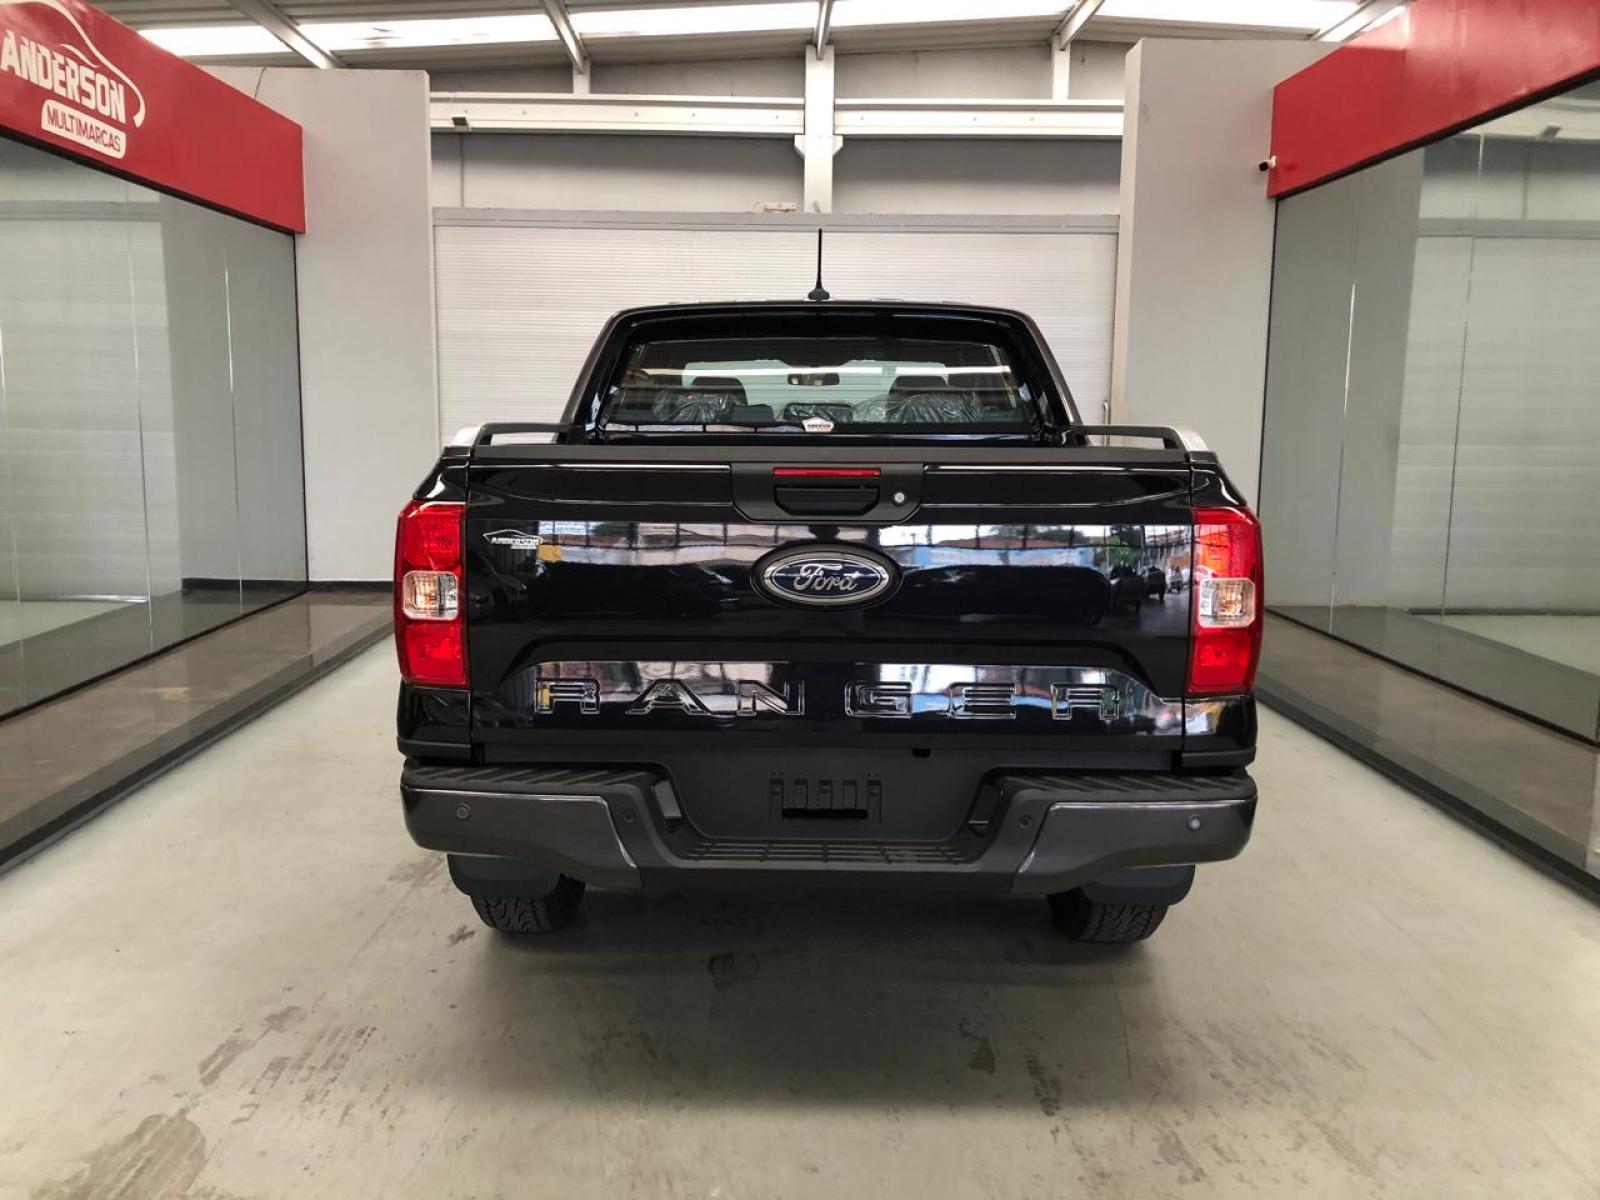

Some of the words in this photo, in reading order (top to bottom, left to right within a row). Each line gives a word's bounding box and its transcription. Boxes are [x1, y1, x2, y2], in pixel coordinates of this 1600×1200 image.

[0, 29, 126, 124] ANDERSON
[46, 104, 121, 153] MULTIMARCAS
[793, 562, 858, 591] Ford
[534, 678, 1120, 721] RANGER
